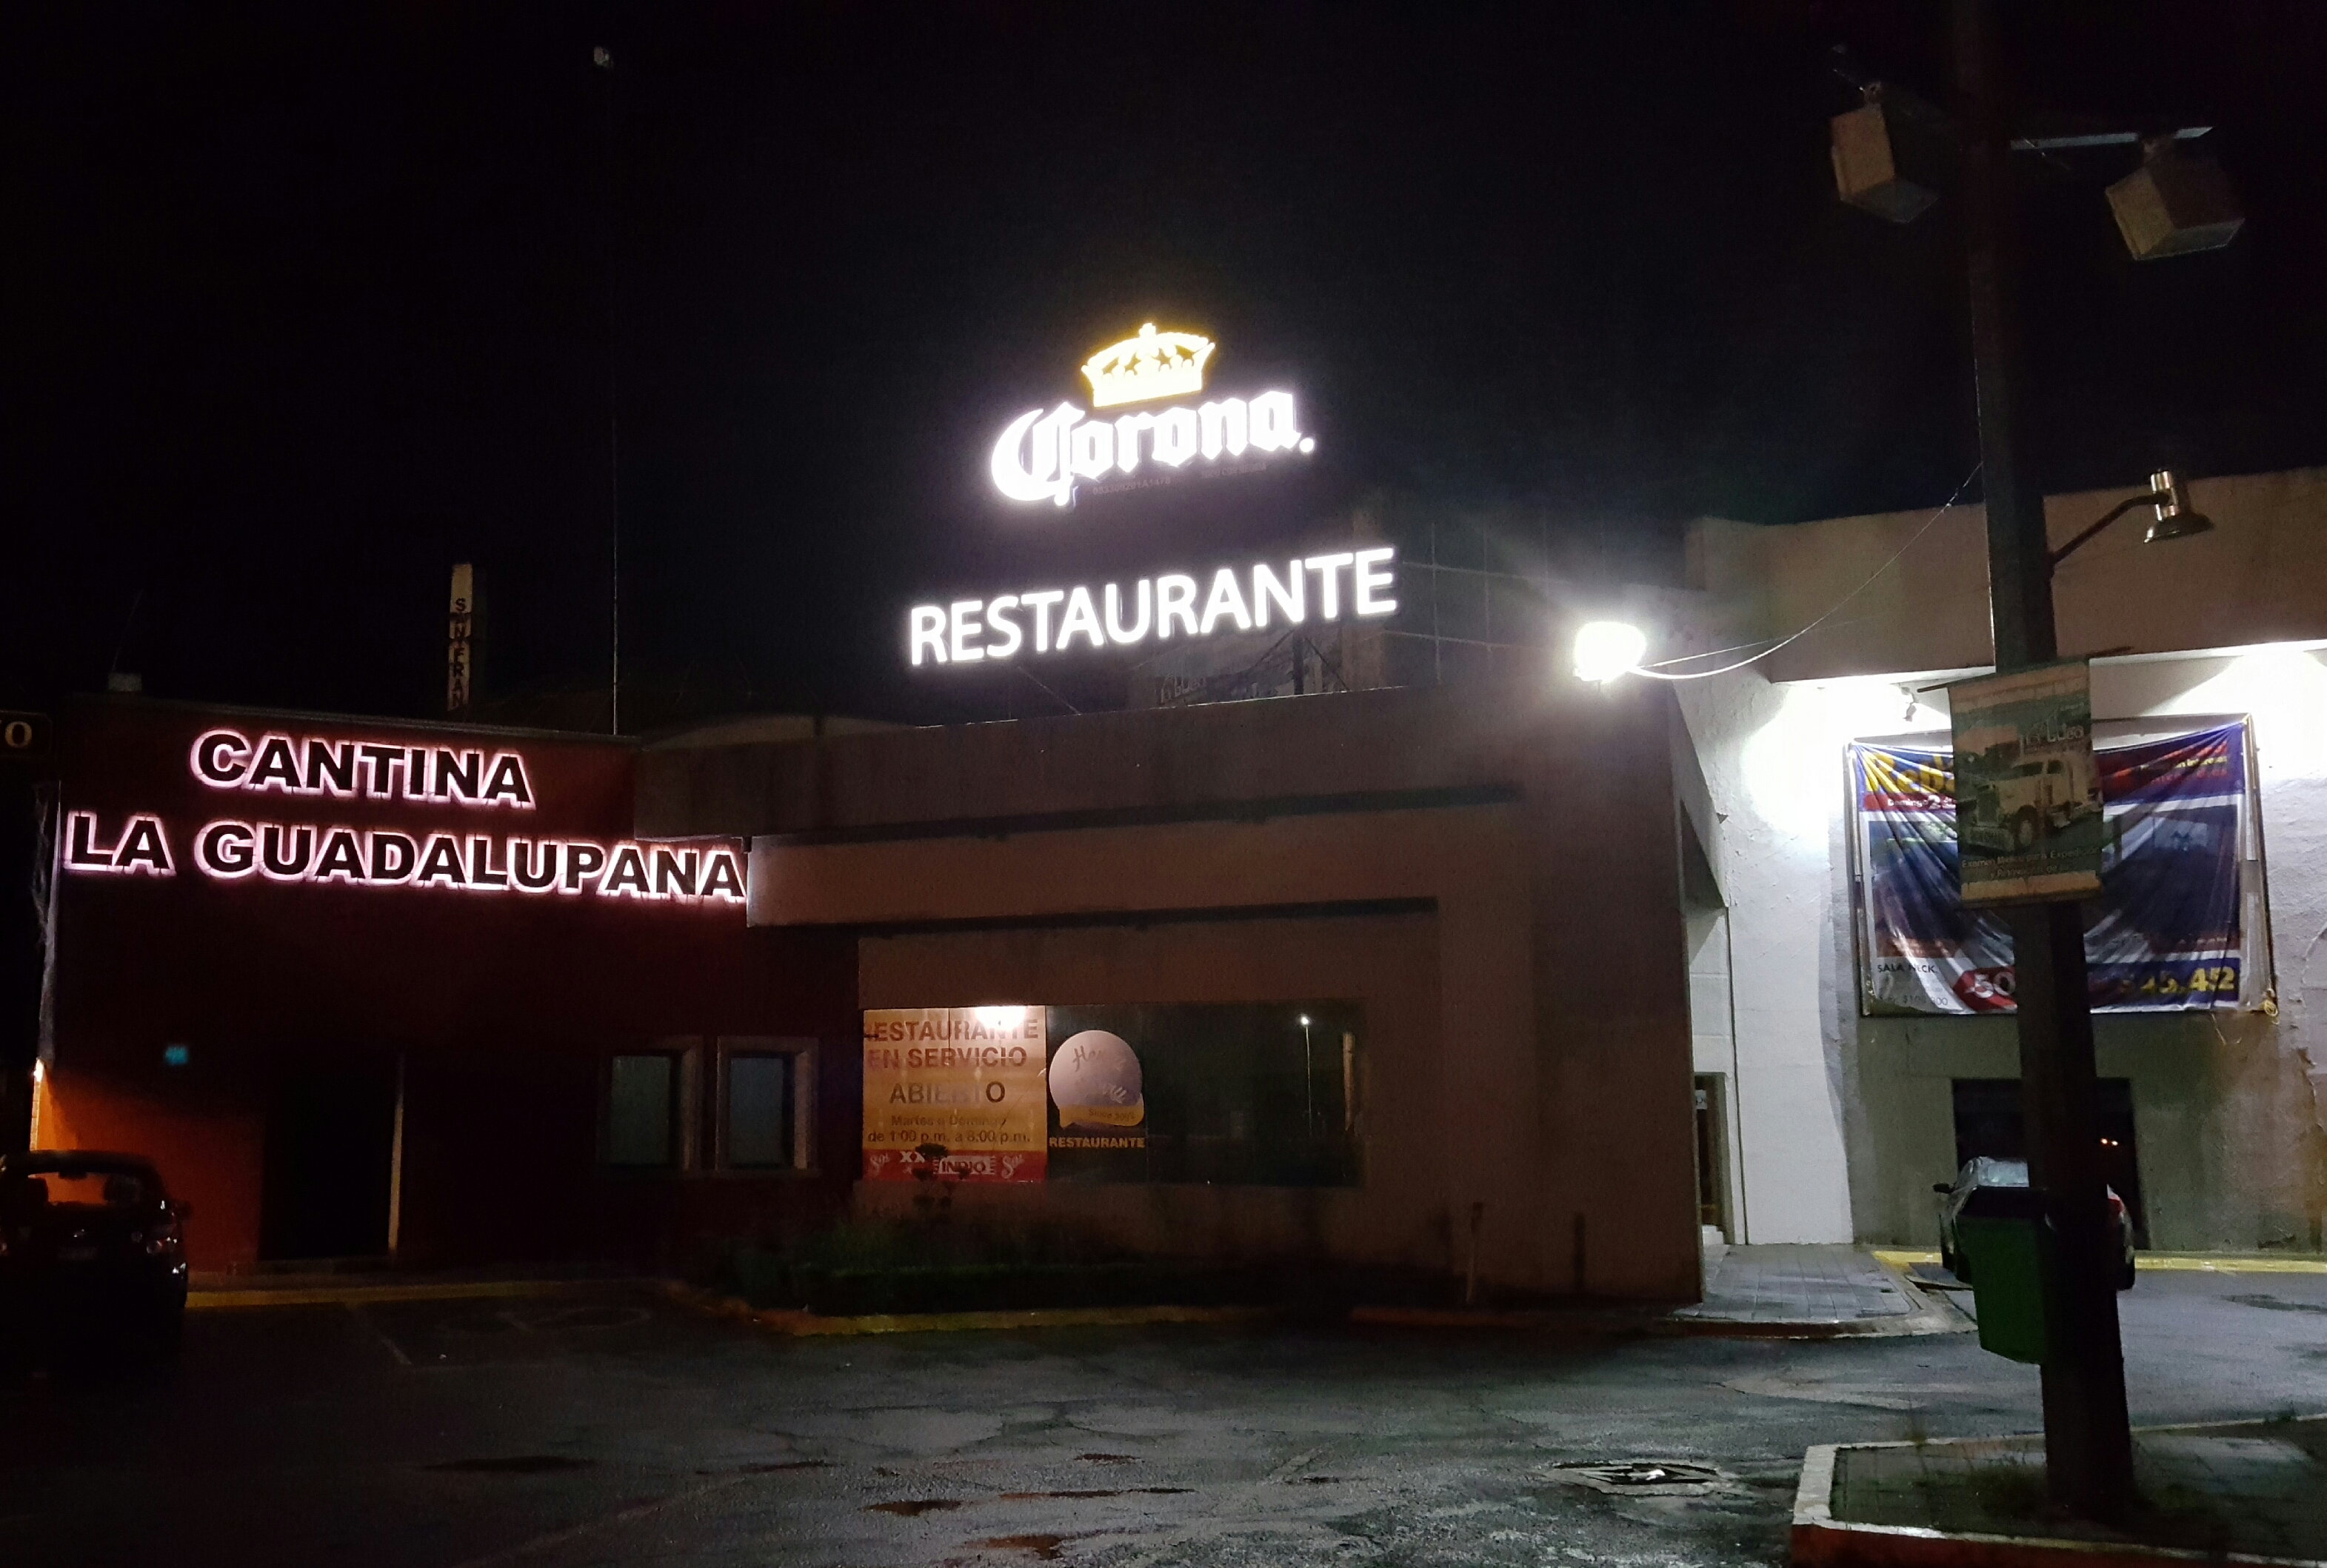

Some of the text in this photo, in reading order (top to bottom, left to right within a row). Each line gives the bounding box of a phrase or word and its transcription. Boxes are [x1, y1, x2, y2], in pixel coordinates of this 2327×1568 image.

[909, 547, 1398, 667] RESTAURANTE
[193, 732, 531, 806] CANTINA
[68, 813, 746, 899] LA GUADALUPANA
[868, 1046, 1027, 1069] EN SERVICIO
[868, 1130, 884, 1142] de
[1049, 1136, 1146, 1149] RESTAURANTE
